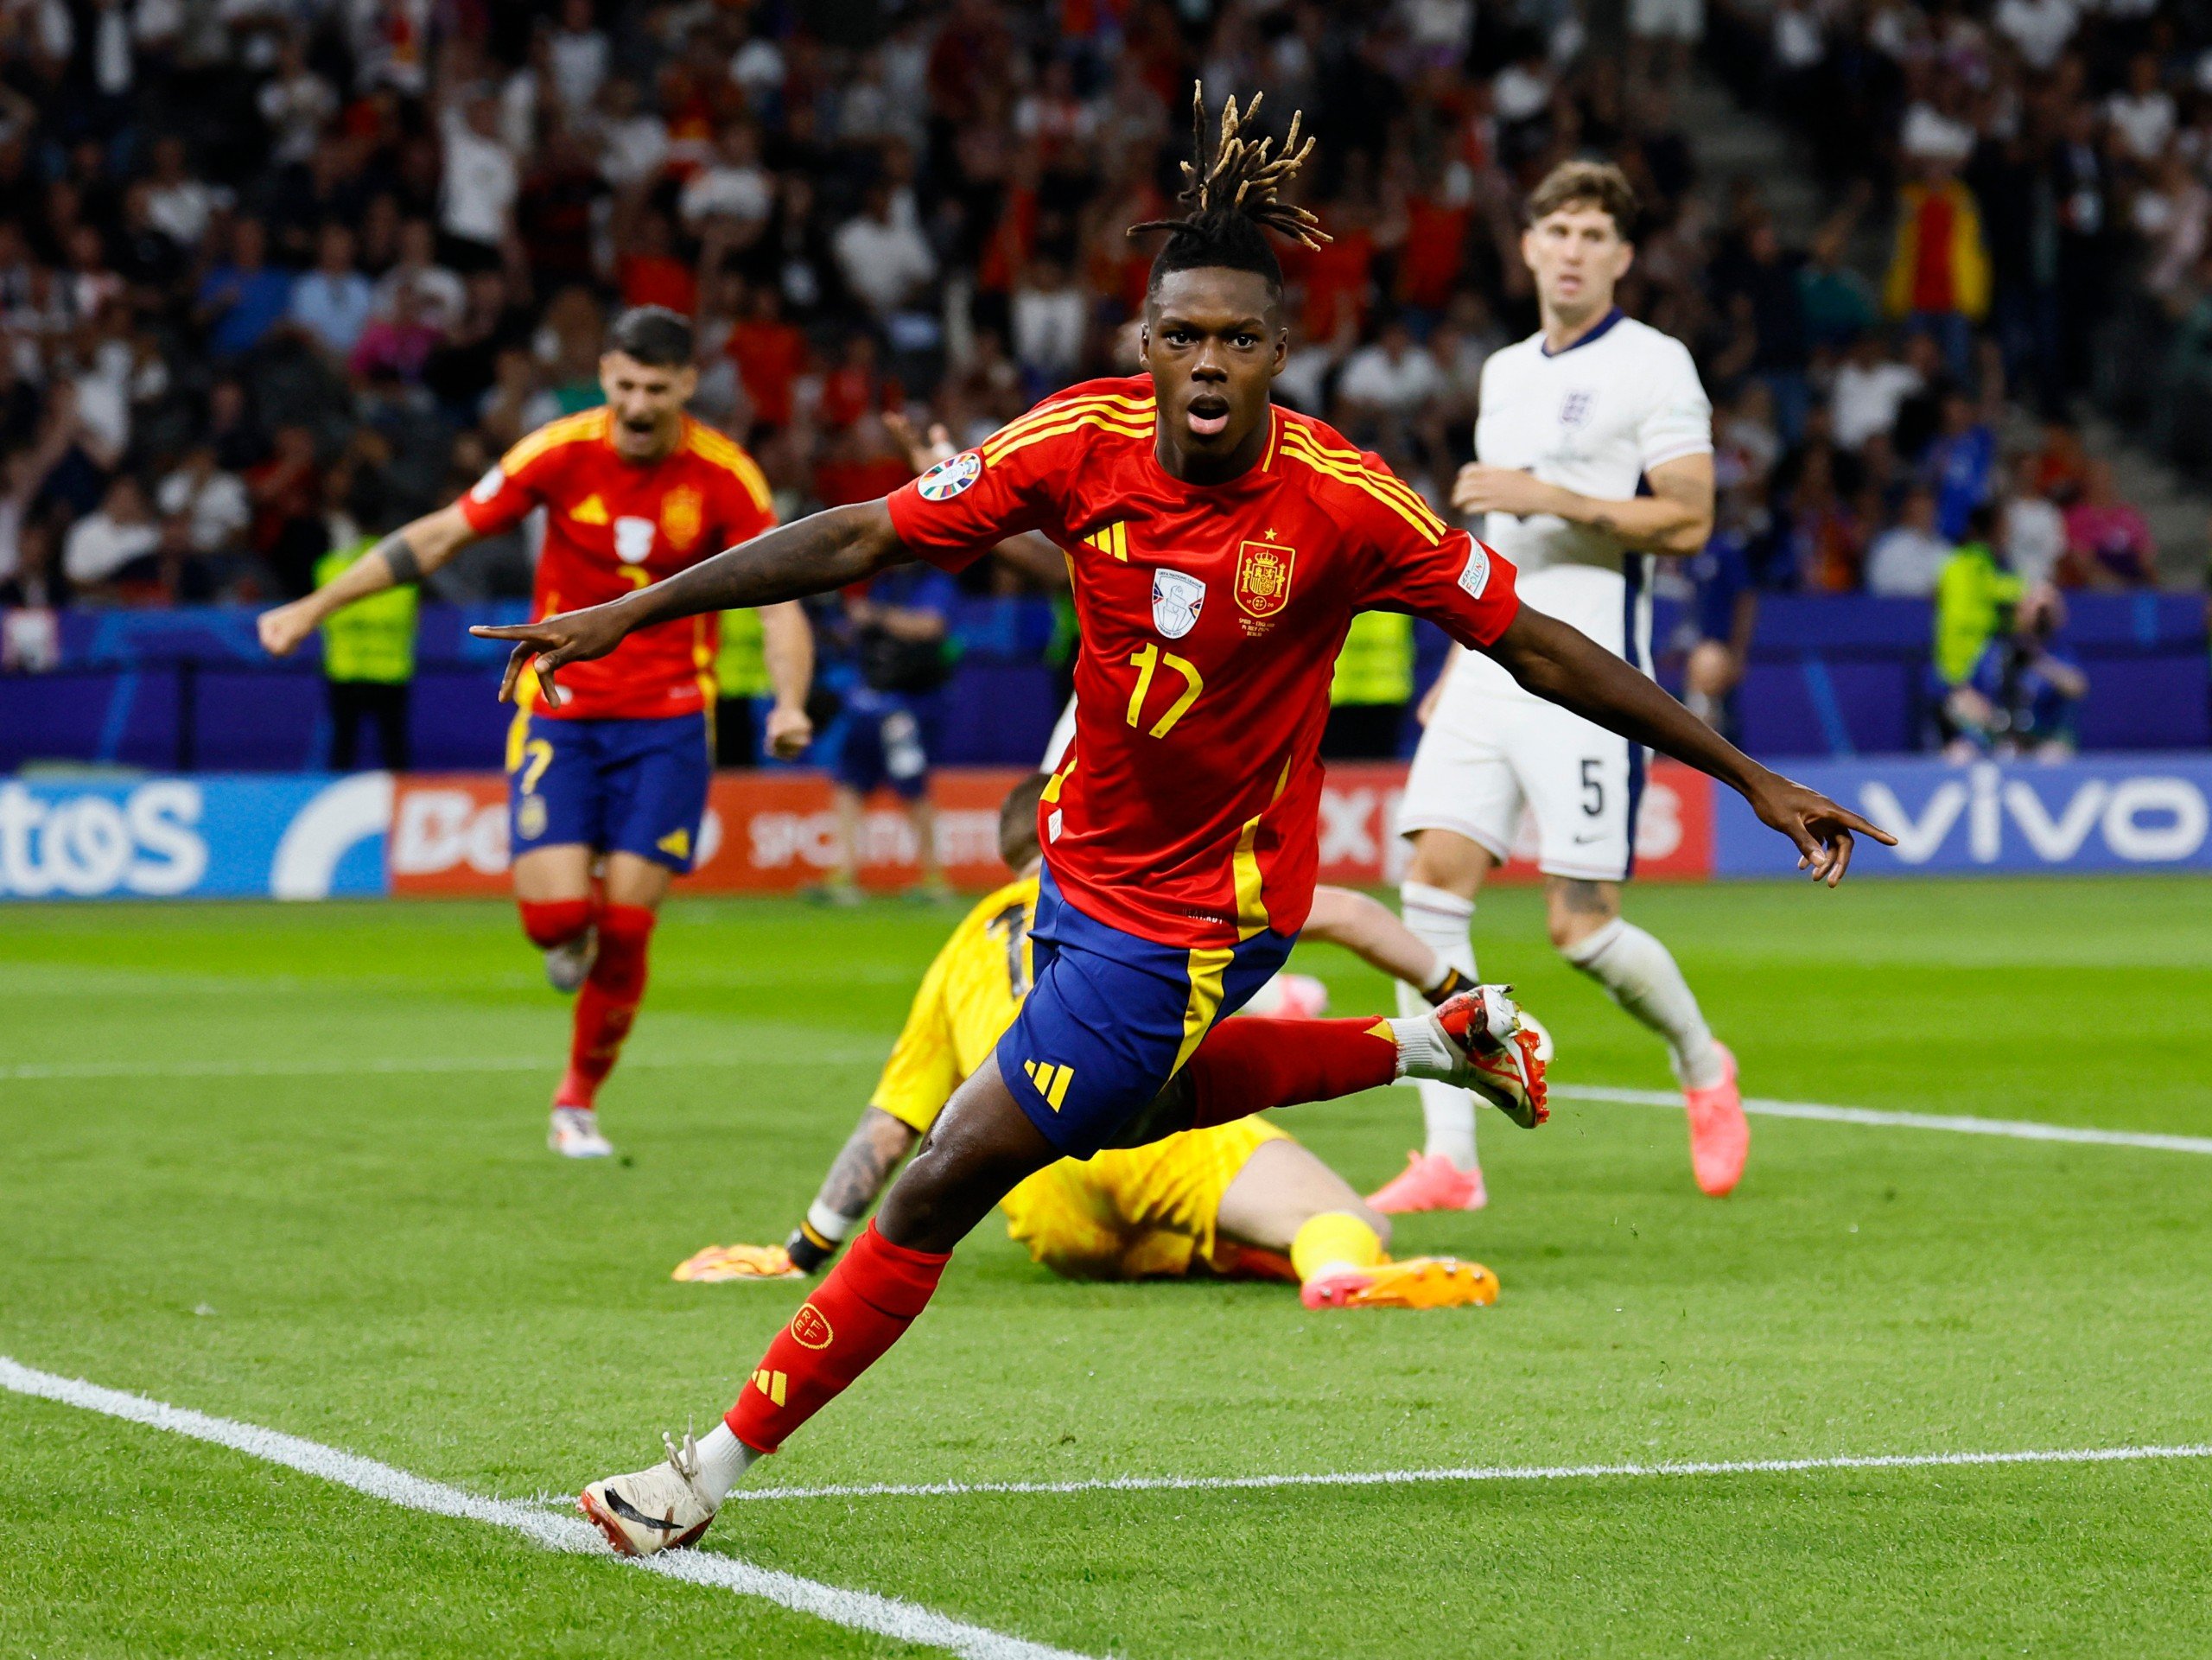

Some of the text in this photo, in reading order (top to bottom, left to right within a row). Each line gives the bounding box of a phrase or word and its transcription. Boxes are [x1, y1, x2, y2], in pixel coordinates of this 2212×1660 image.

[1130, 642, 1204, 739] 17
[525, 739, 554, 796] 7
[1581, 759, 1603, 817] 5
[1858, 762, 2209, 863] vivo
